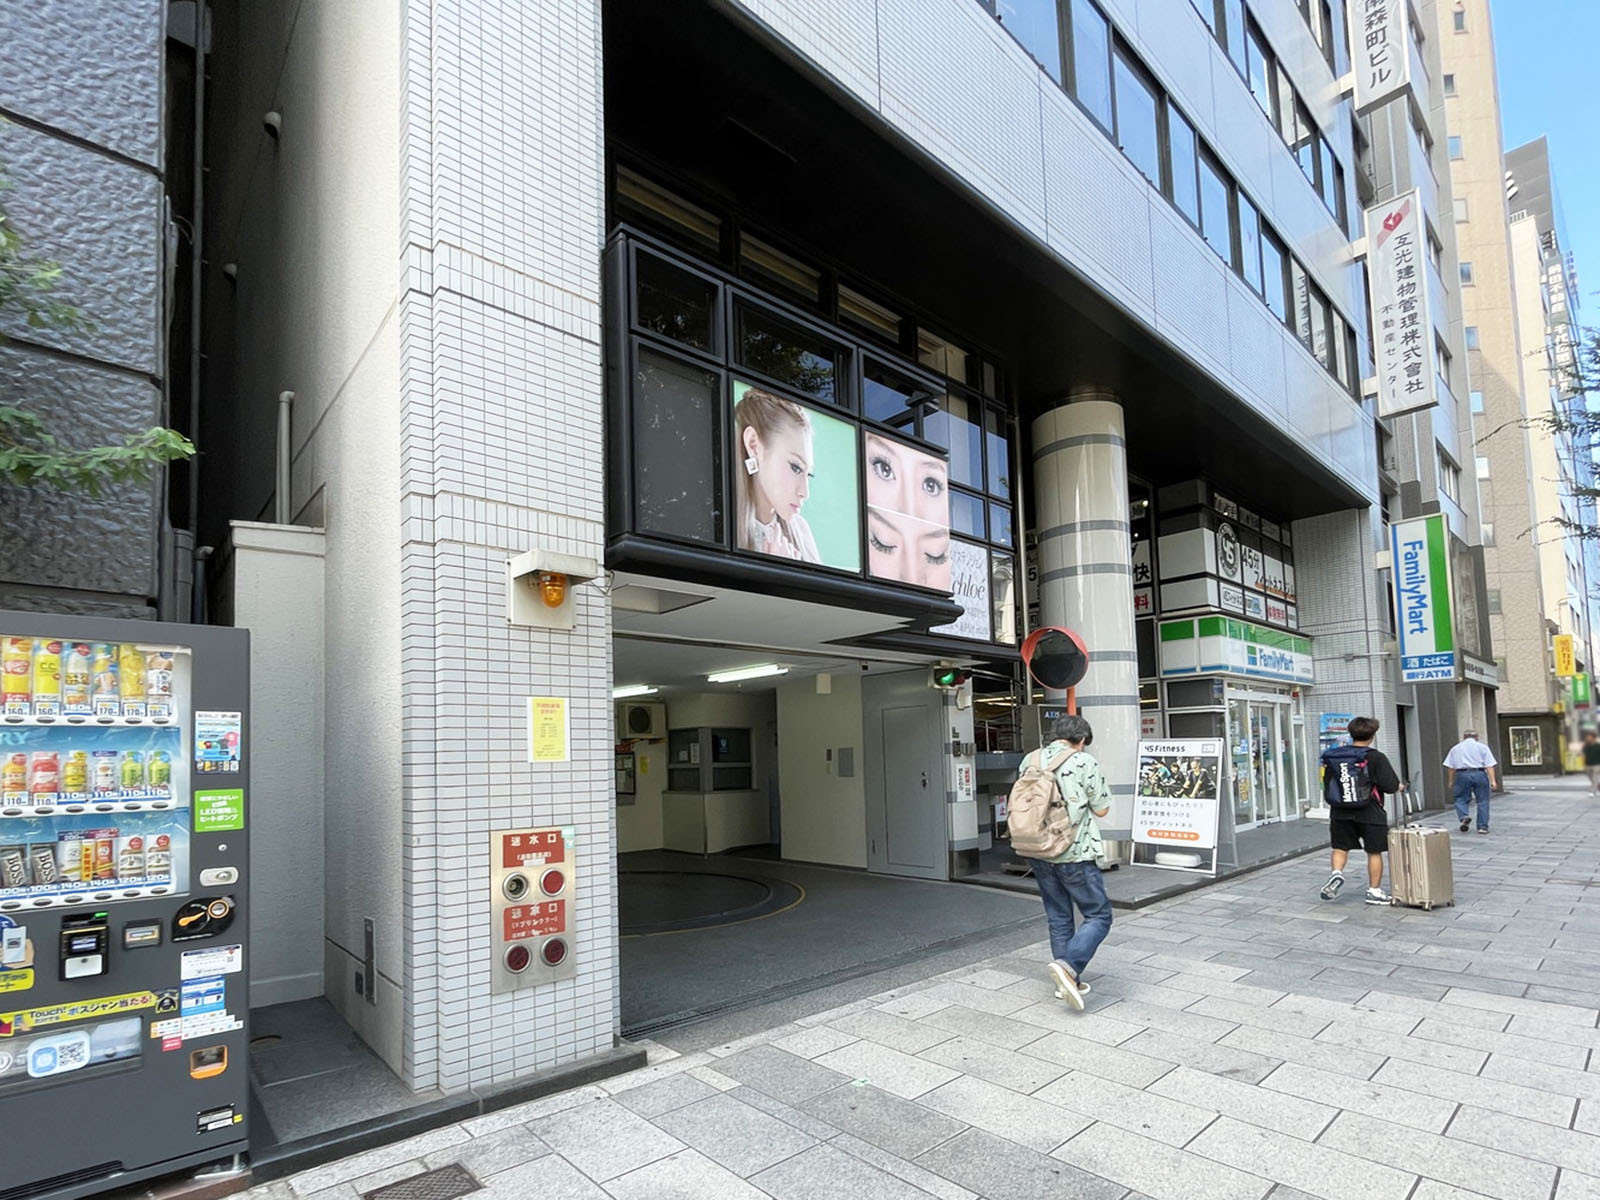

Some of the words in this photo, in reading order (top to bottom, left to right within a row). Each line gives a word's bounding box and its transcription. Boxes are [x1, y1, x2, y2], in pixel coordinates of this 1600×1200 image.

[951, 572, 986, 600] chloé
[1400, 540, 1428, 635] FamilyMart
[1258, 647, 1294, 672] FamilyMart
[8, 857, 24, 885] BOSS
[39, 854, 55, 882] BOSS
[30, 1006, 66, 1018] Touch!
